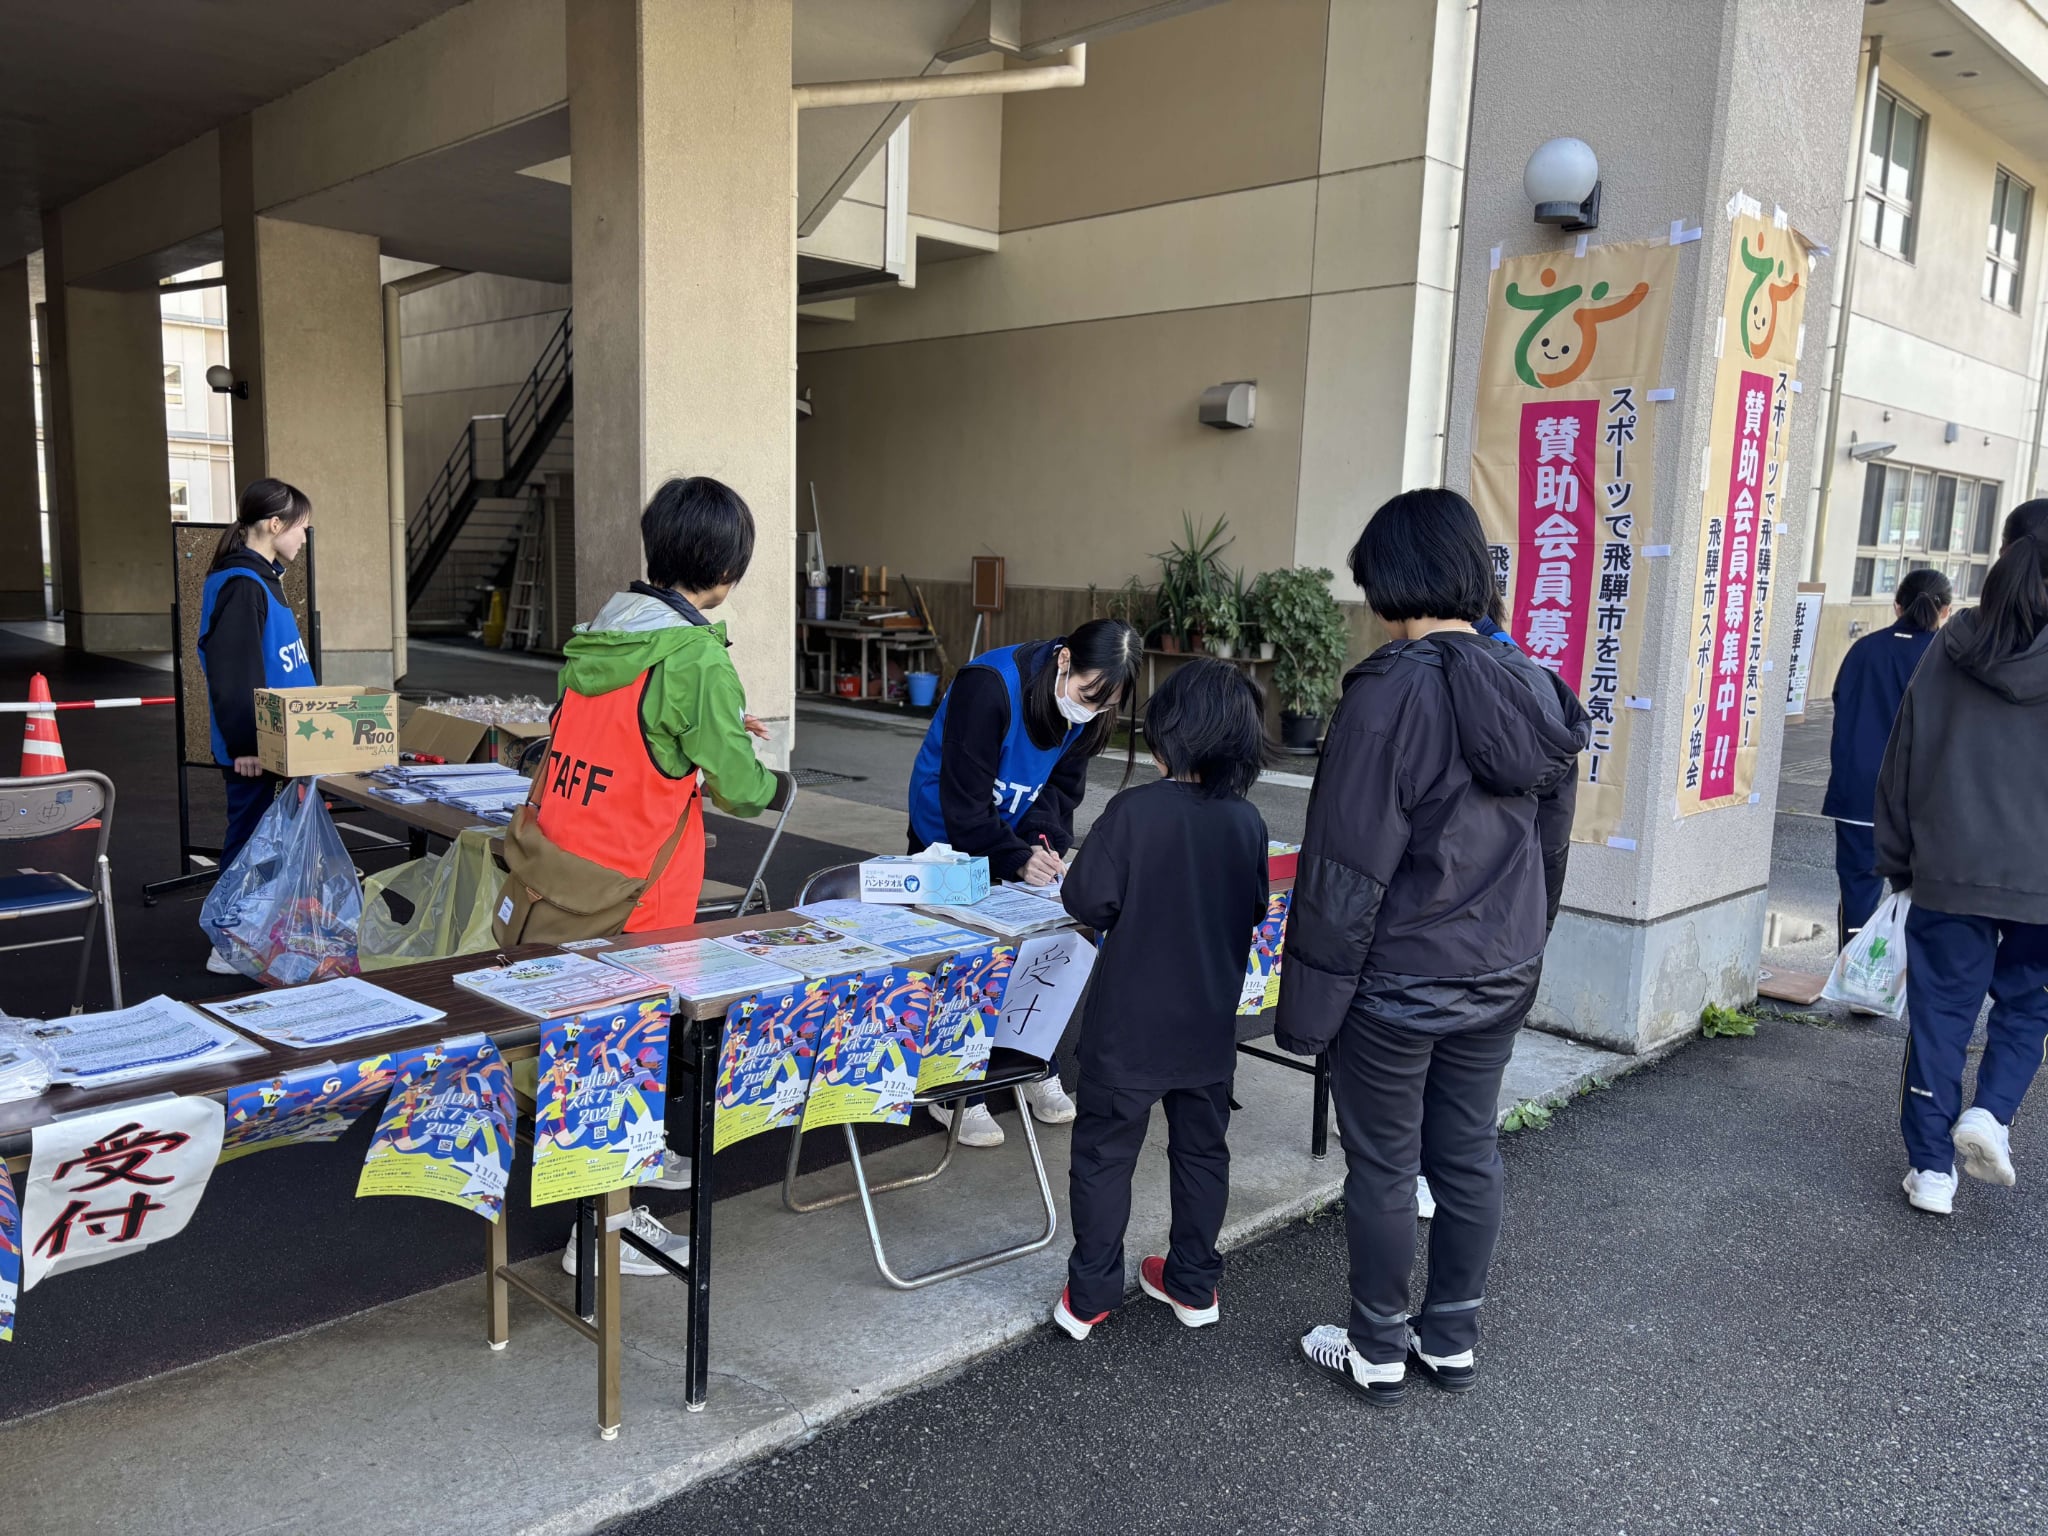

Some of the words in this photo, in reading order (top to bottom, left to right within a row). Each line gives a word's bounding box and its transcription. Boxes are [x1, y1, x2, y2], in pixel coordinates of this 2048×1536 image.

[1685, 518, 1722, 789] 飛騨市スポーツ協会
[305, 700, 358, 712] サンエース
[353, 719, 395, 745] R100
[378, 744, 395, 756] A4
[570, 1028, 580, 1038] 17
[430, 1058, 442, 1067] 17
[268, 1093, 281, 1104] 17
[578, 1104, 622, 1124] 2025
[423, 1122, 474, 1138] 2025
[32, 1122, 191, 1259] 受付
